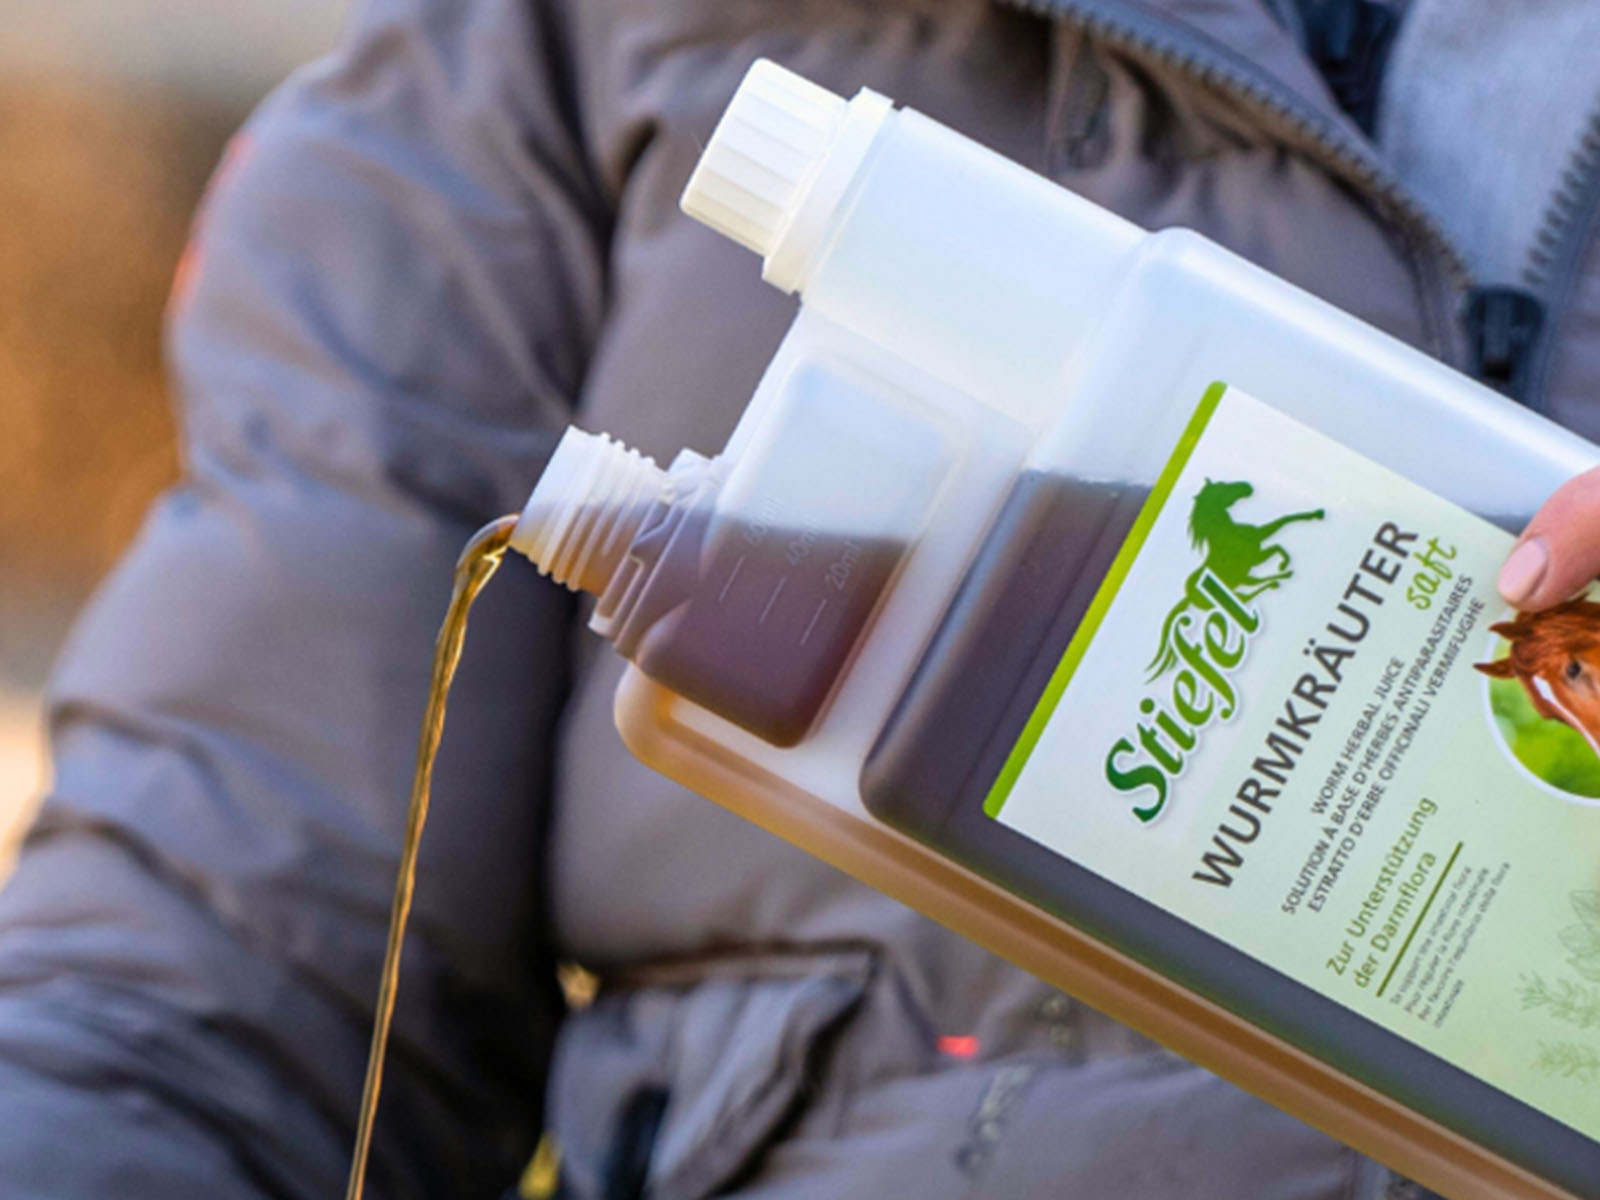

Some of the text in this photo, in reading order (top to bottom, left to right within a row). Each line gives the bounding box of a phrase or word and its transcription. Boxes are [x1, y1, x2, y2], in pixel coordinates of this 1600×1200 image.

[1407, 537, 1457, 610] saft
[1108, 573, 1261, 823] Stiefel
[1192, 522, 1418, 887] WURMKRÄUTER
[1281, 833, 1334, 914] SOLUTION
[1330, 786, 1360, 825] BASE
[1352, 713, 1399, 784] D'HERBES
[1393, 576, 1472, 711] ANTIPARASITAIRES
[1307, 598, 1486, 912] ESTRATTO D'ERBE OFFICINALI VERMIFUGHE
[1311, 658, 1404, 814] WORM HERBAL JUICE
[1326, 798, 1438, 976] Zur Unterstützung
[1354, 954, 1378, 988] der
[1370, 852, 1436, 952] Darmflora
